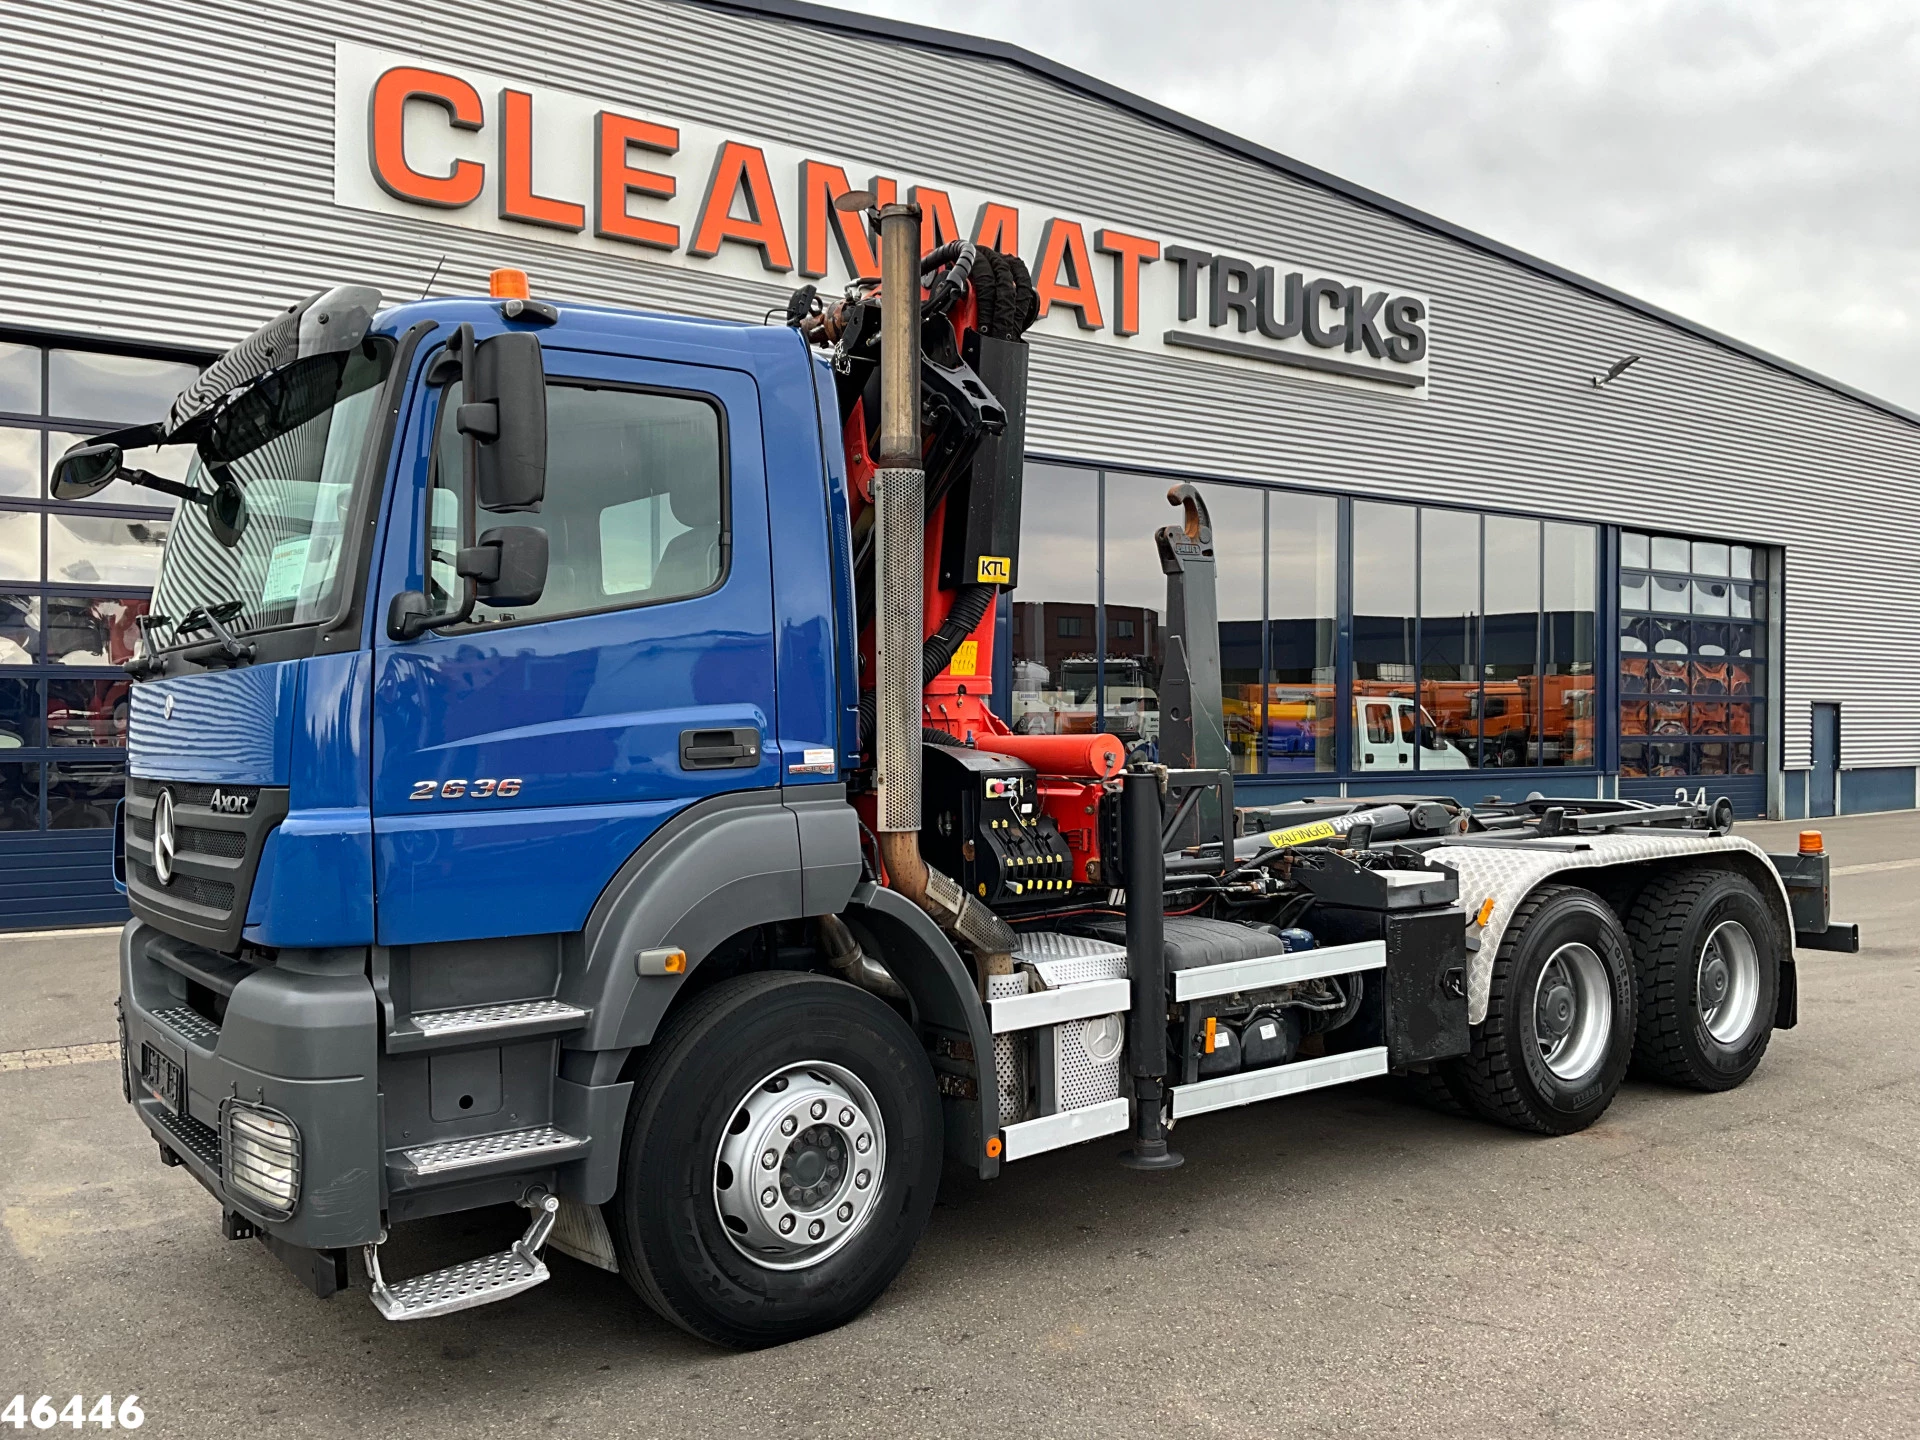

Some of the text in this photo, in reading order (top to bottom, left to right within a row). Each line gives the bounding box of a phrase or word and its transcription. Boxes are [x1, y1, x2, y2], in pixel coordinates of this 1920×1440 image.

[1163, 244, 1428, 364] TRUCKS
[981, 560, 1007, 577] KTL
[408, 778, 523, 800] 2636
[1272, 823, 1333, 846] PALFINGER
